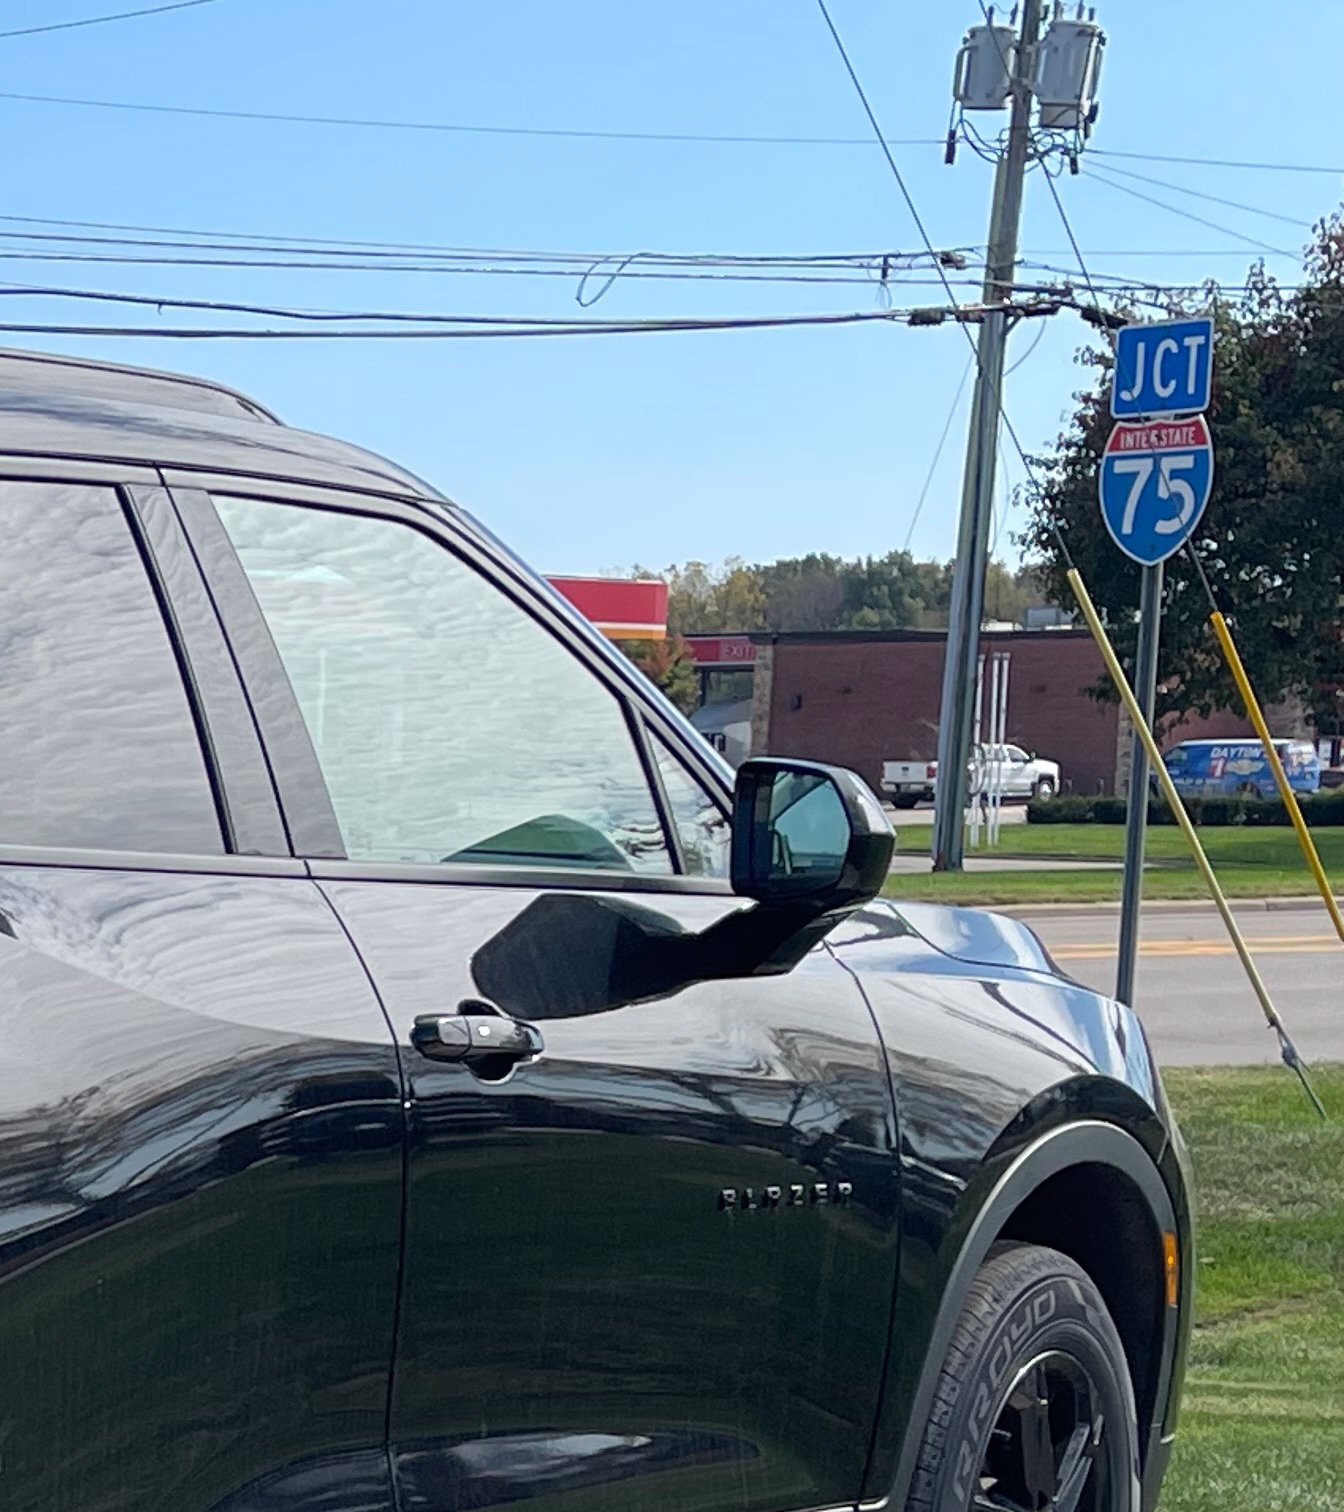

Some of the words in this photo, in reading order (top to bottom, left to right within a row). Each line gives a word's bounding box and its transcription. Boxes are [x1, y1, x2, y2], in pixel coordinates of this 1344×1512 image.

[1120, 335, 1206, 401] JCT
[1120, 426, 1196, 449] INTERSTATE
[1113, 455, 1195, 534] 75
[718, 1181, 853, 1212] BLAZER
